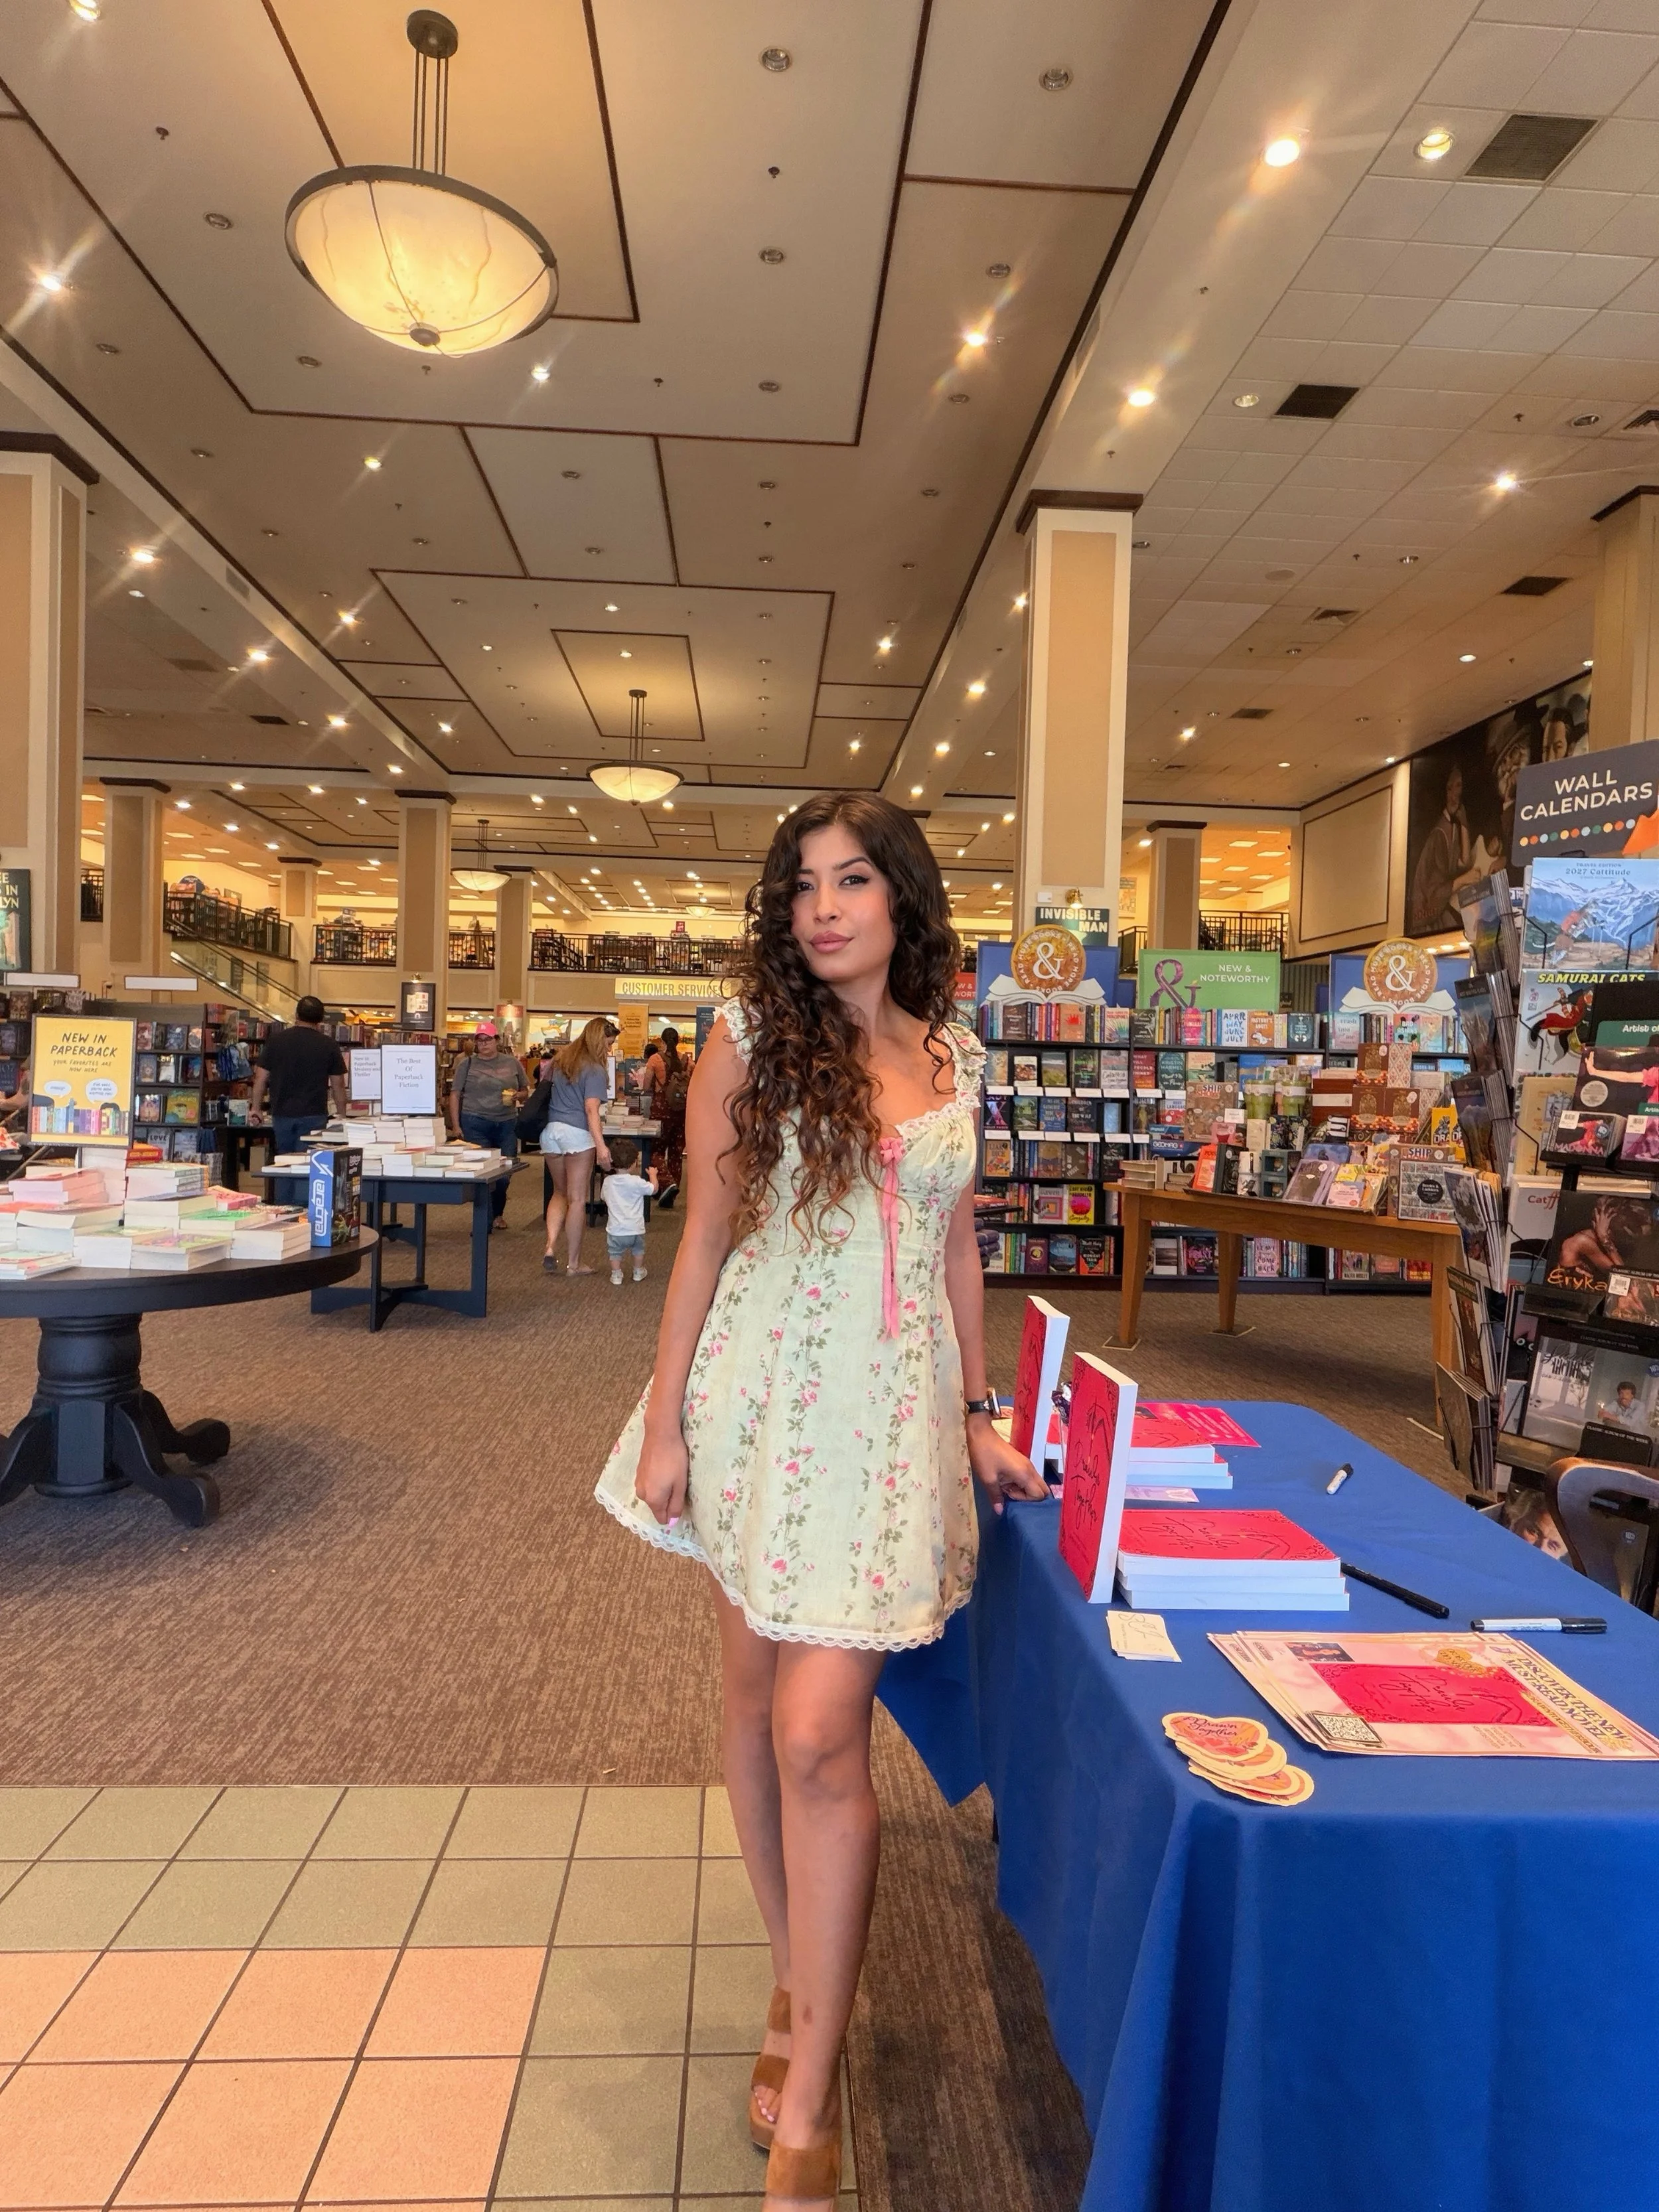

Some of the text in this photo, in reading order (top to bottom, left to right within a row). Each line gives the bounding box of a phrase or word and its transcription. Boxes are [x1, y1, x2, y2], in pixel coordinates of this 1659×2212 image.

[1555, 769, 1617, 795] WALL
[1520, 782, 1653, 821] CALENDARS
[6, 885, 18, 896] IN
[1041, 908, 1100, 921] INVISIBLE
[1078, 921, 1108, 932] MAN
[1033, 942, 1064, 980] &
[1200, 974, 1270, 983] NOTEWORTHY
[1386, 955, 1416, 992] &
[1538, 974, 1646, 984] SAMURAI CATS
[622, 982, 674, 996] CUSTOMER
[62, 1033, 107, 1044] NEW IN
[50, 1045, 117, 1057] PAPERBACK
[1554, 1143, 1605, 1155] MADONNA
[1503, 1659, 1569, 1710] MUST-READ
[1563, 1708, 1607, 1737] NOVEL
[1518, 1659, 1632, 1740] DISCOVER THE NEW
[1183, 1717, 1238, 1729] Drawn
[1188, 1722, 1238, 1736] Together
